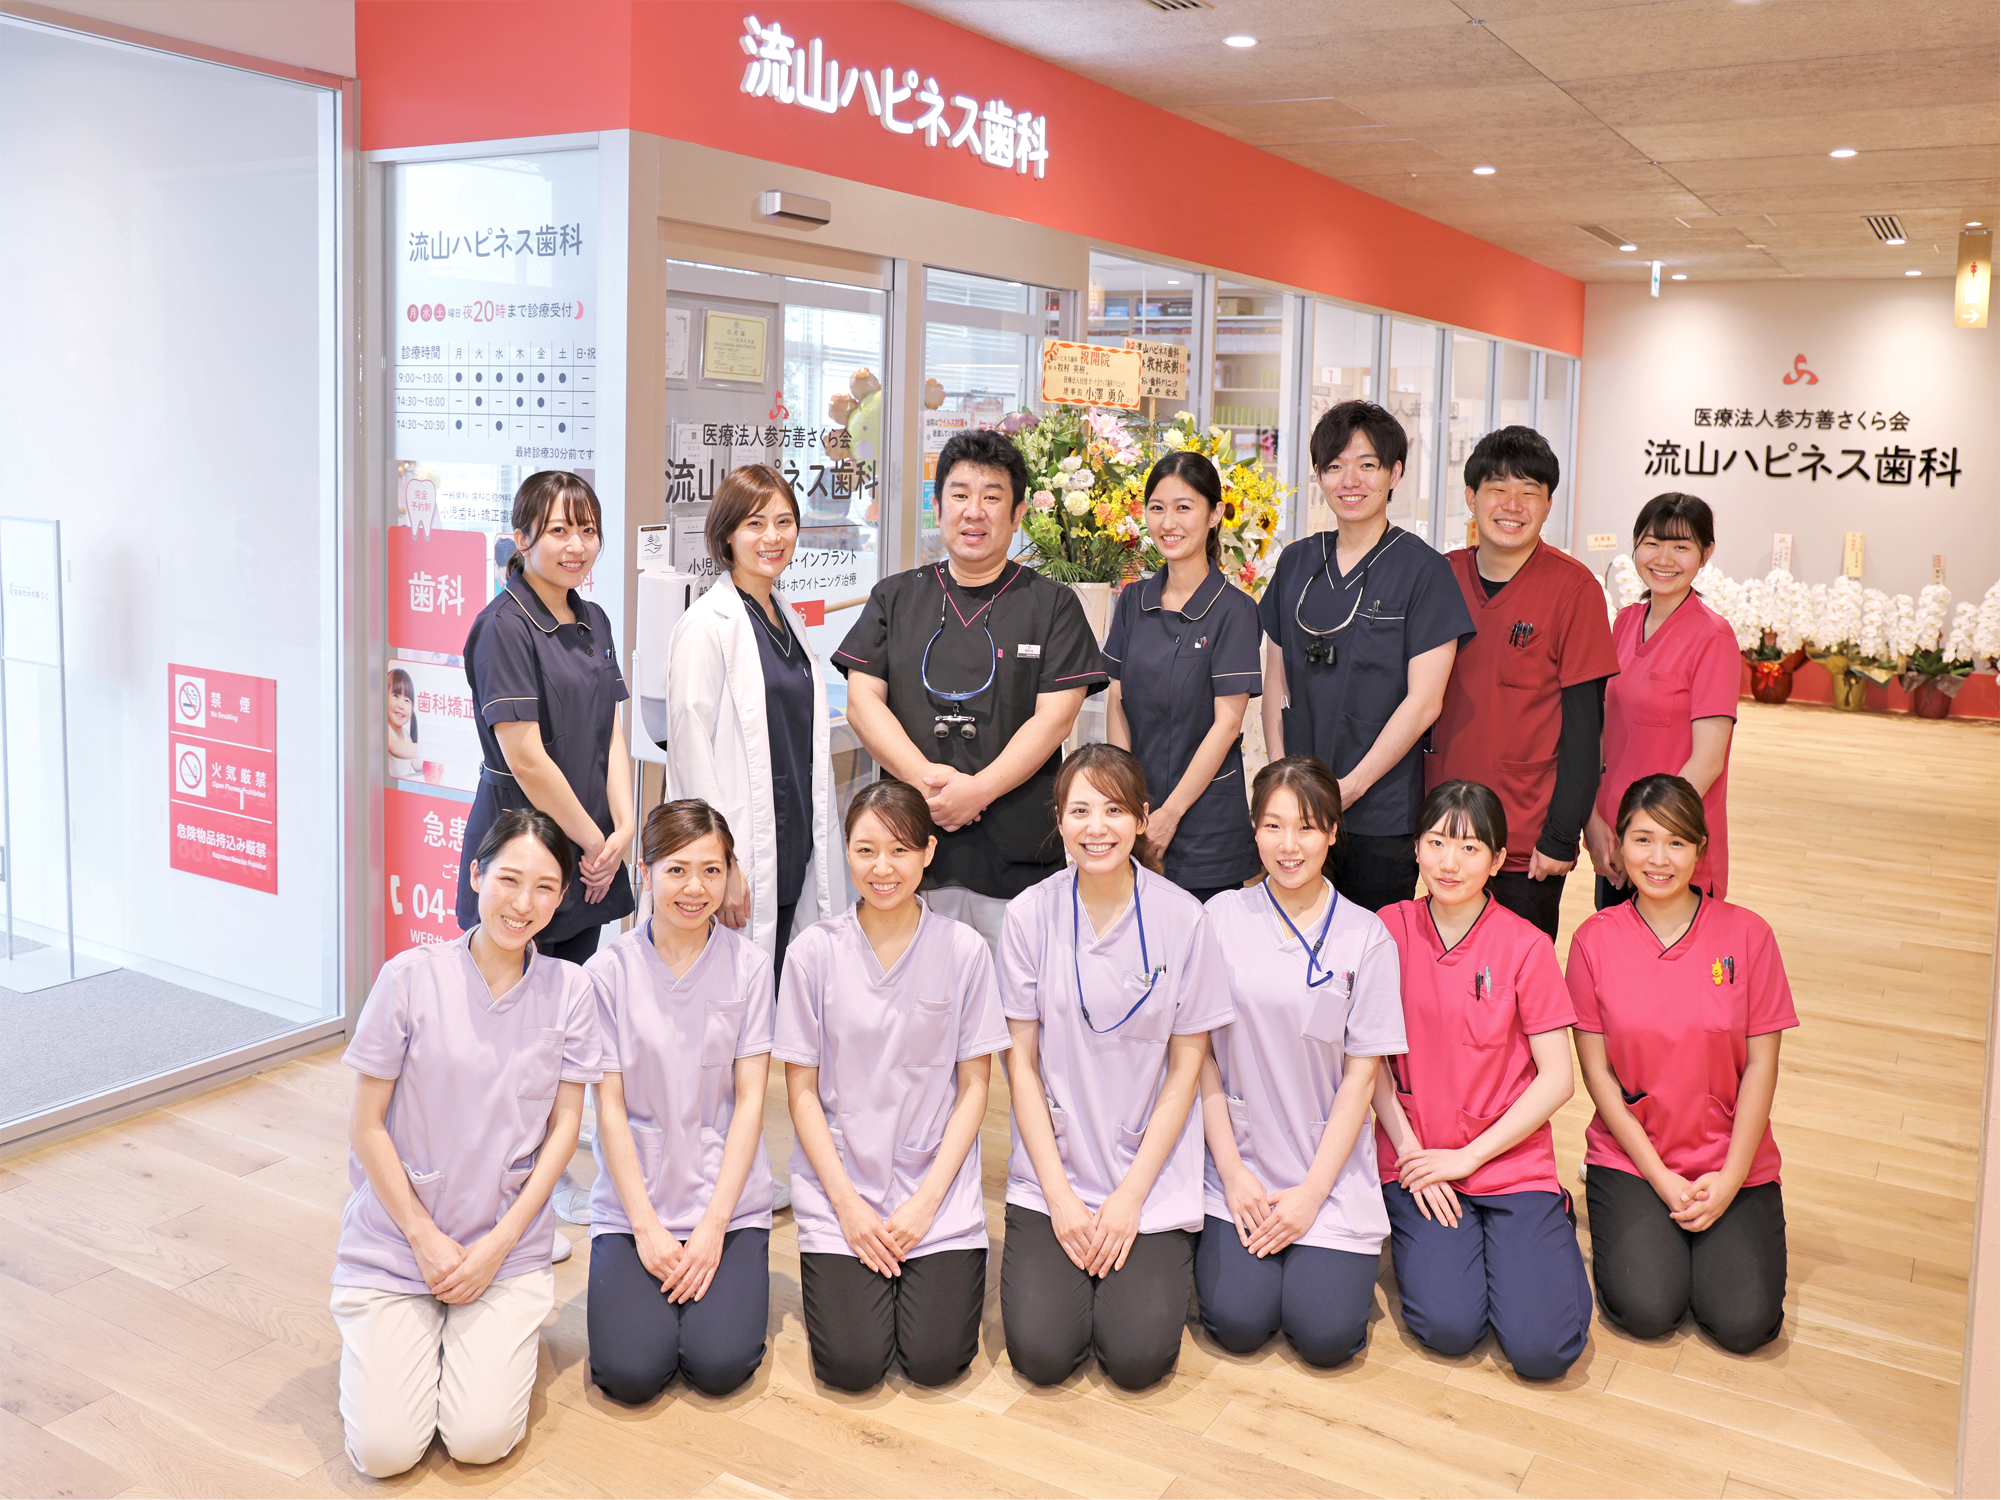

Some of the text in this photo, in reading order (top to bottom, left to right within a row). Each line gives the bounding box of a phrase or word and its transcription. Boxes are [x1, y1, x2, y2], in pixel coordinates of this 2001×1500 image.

[739, 15, 1049, 179] 流山ハピネス歯科
[408, 222, 583, 262] 流山ハピネス歯科
[401, 346, 440, 360] 診療時間
[1080, 350, 1111, 367] 祝開院
[1694, 408, 1910, 432] 医療法人参方善さくら会
[703, 423, 852, 450] 医療法人参方善さくら会
[515, 446, 595, 460] 最終診療30分前です
[1644, 439, 1962, 488] 流山ハピネス歯科
[665, 457, 879, 503] 流山ネス歯科
[411, 502, 431, 512] 予約制
[414, 490, 428, 500] 完全
[408, 571, 465, 616] 歯科
[210, 710, 238, 723] No Smoking
[416, 690, 475, 719] 歯科矯正
[211, 762, 267, 788] 火気厳禁
[212, 780, 224, 790] Open
[176, 822, 267, 860] 危険物品持込み厳禁
